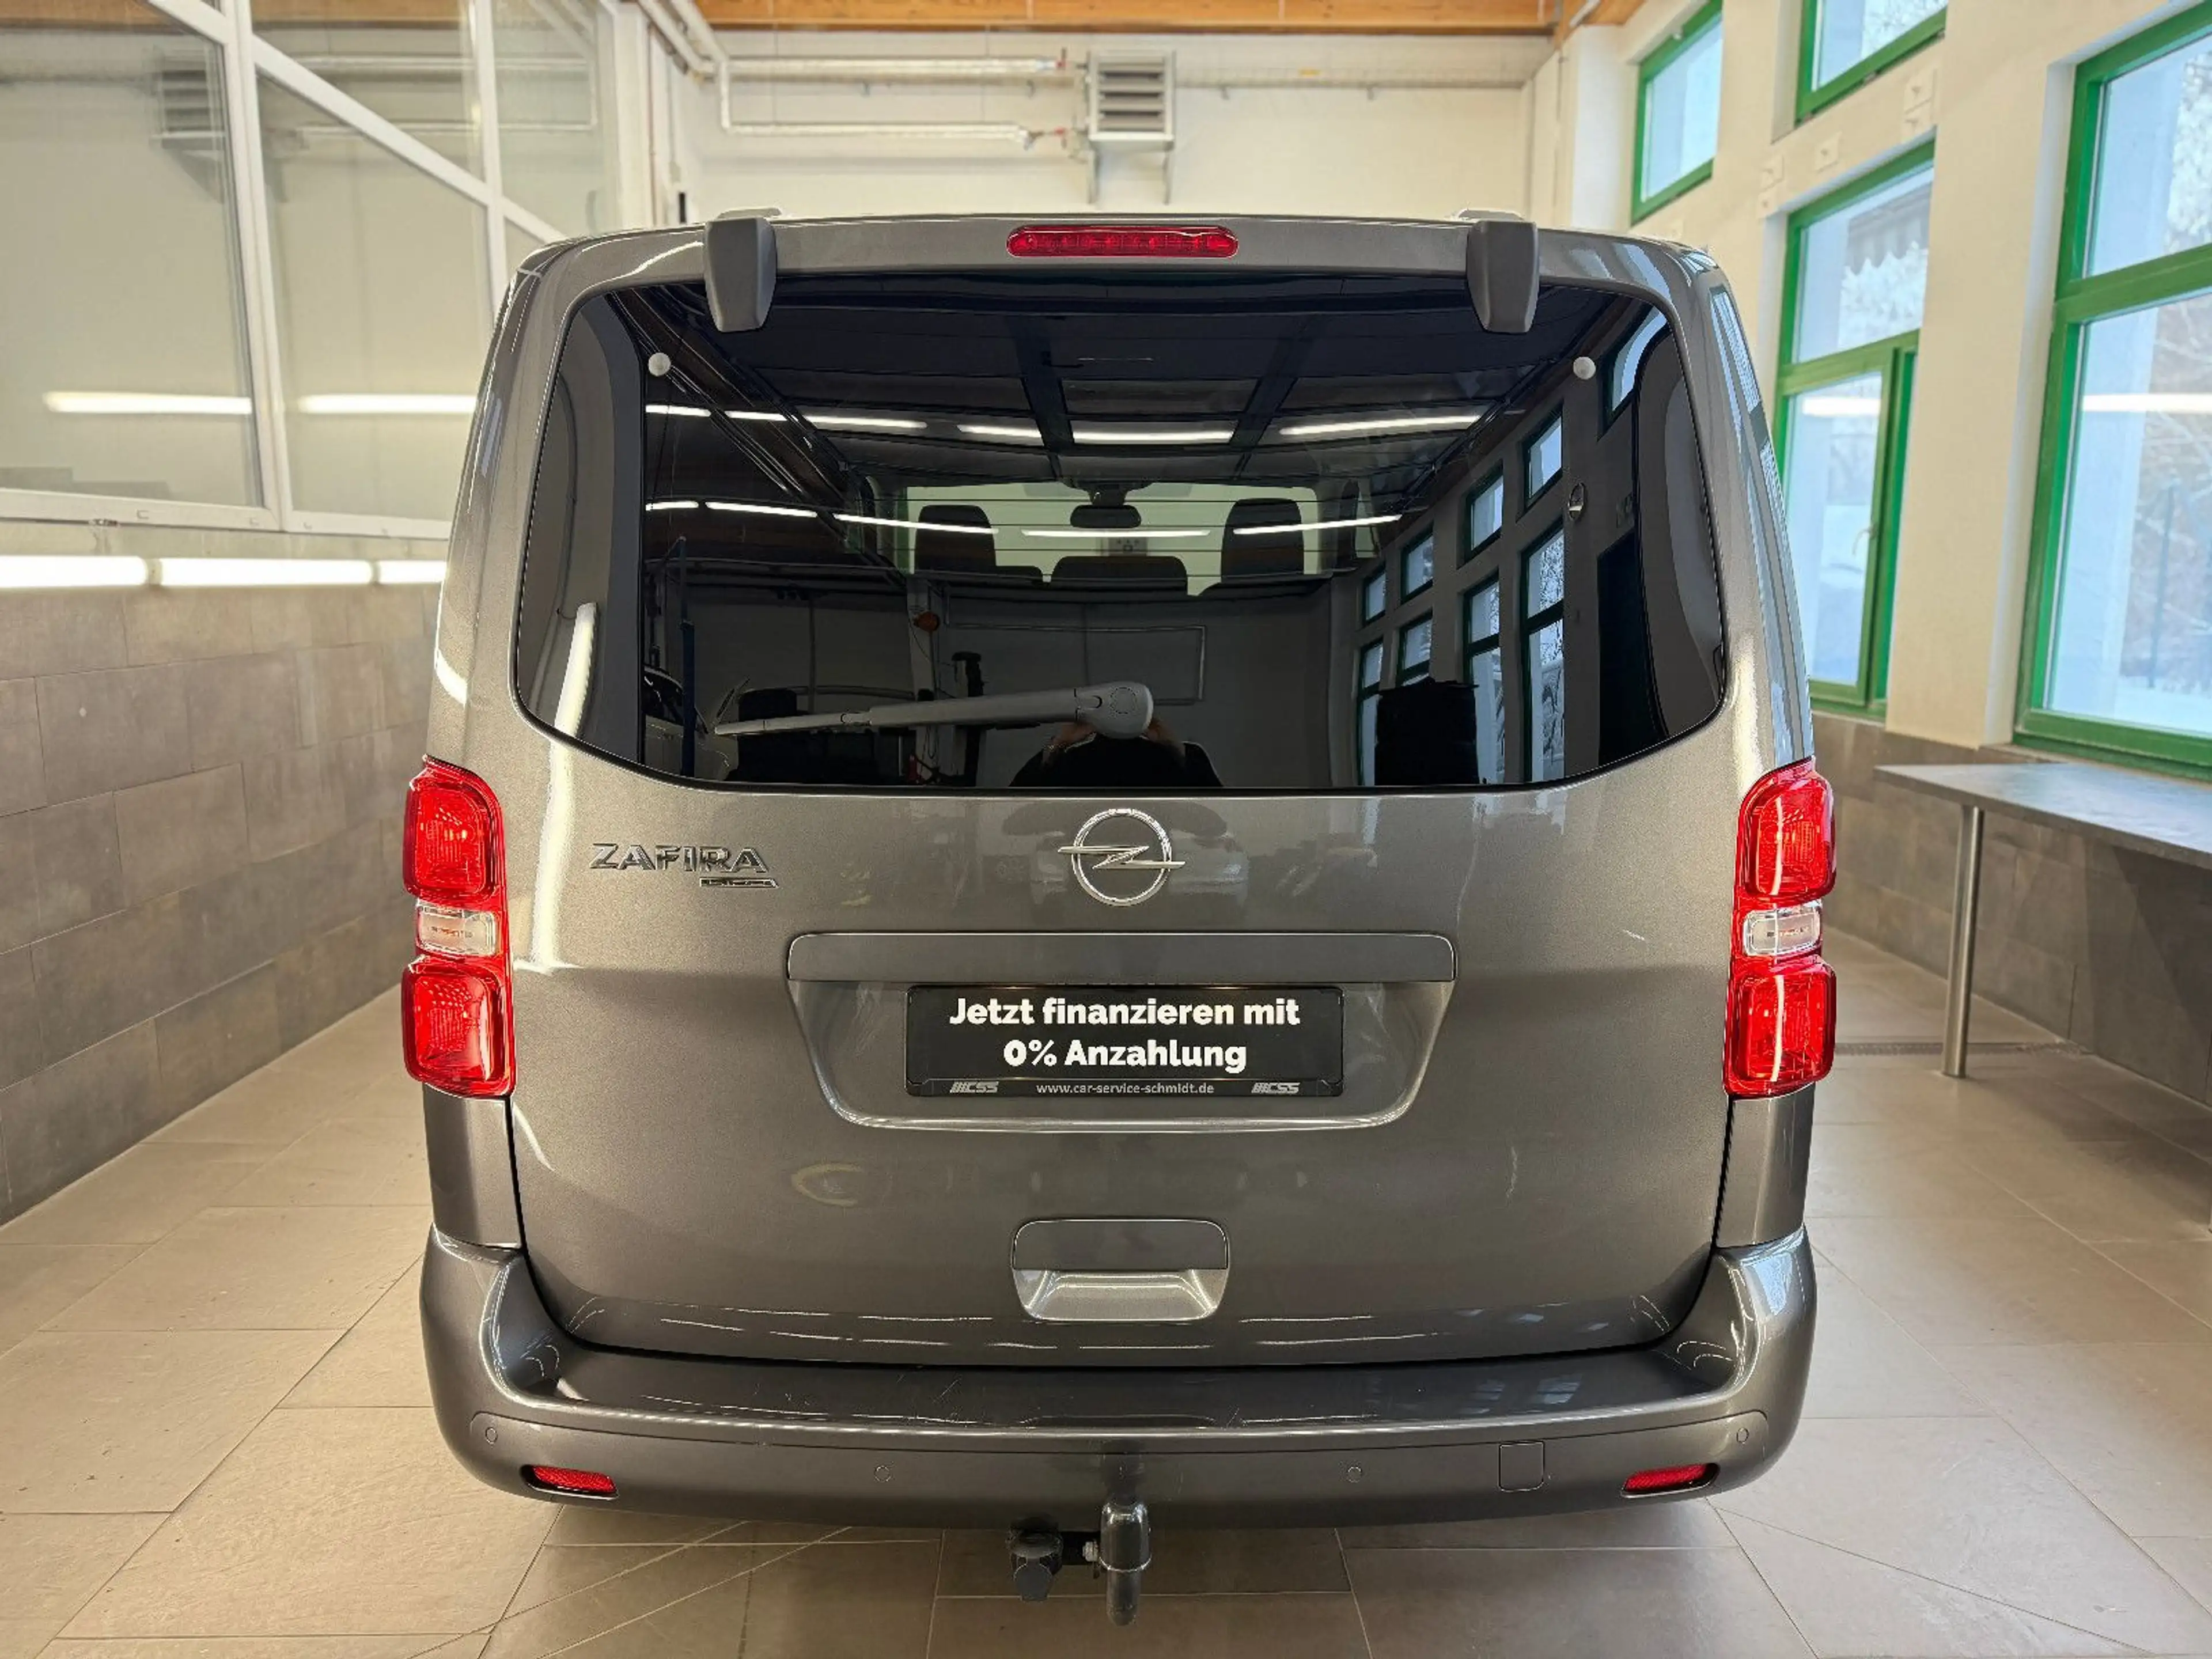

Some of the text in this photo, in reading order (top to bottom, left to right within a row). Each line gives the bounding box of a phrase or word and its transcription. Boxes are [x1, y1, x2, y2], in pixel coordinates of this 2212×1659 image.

[589, 843, 769, 873] ZAFIRA
[949, 997, 1300, 1025] Jetzt finanzieren mit
[1003, 1039, 1247, 1074] 0% Anzahlung
[1036, 1083, 1214, 1094] www.car-service-schmidt.de
